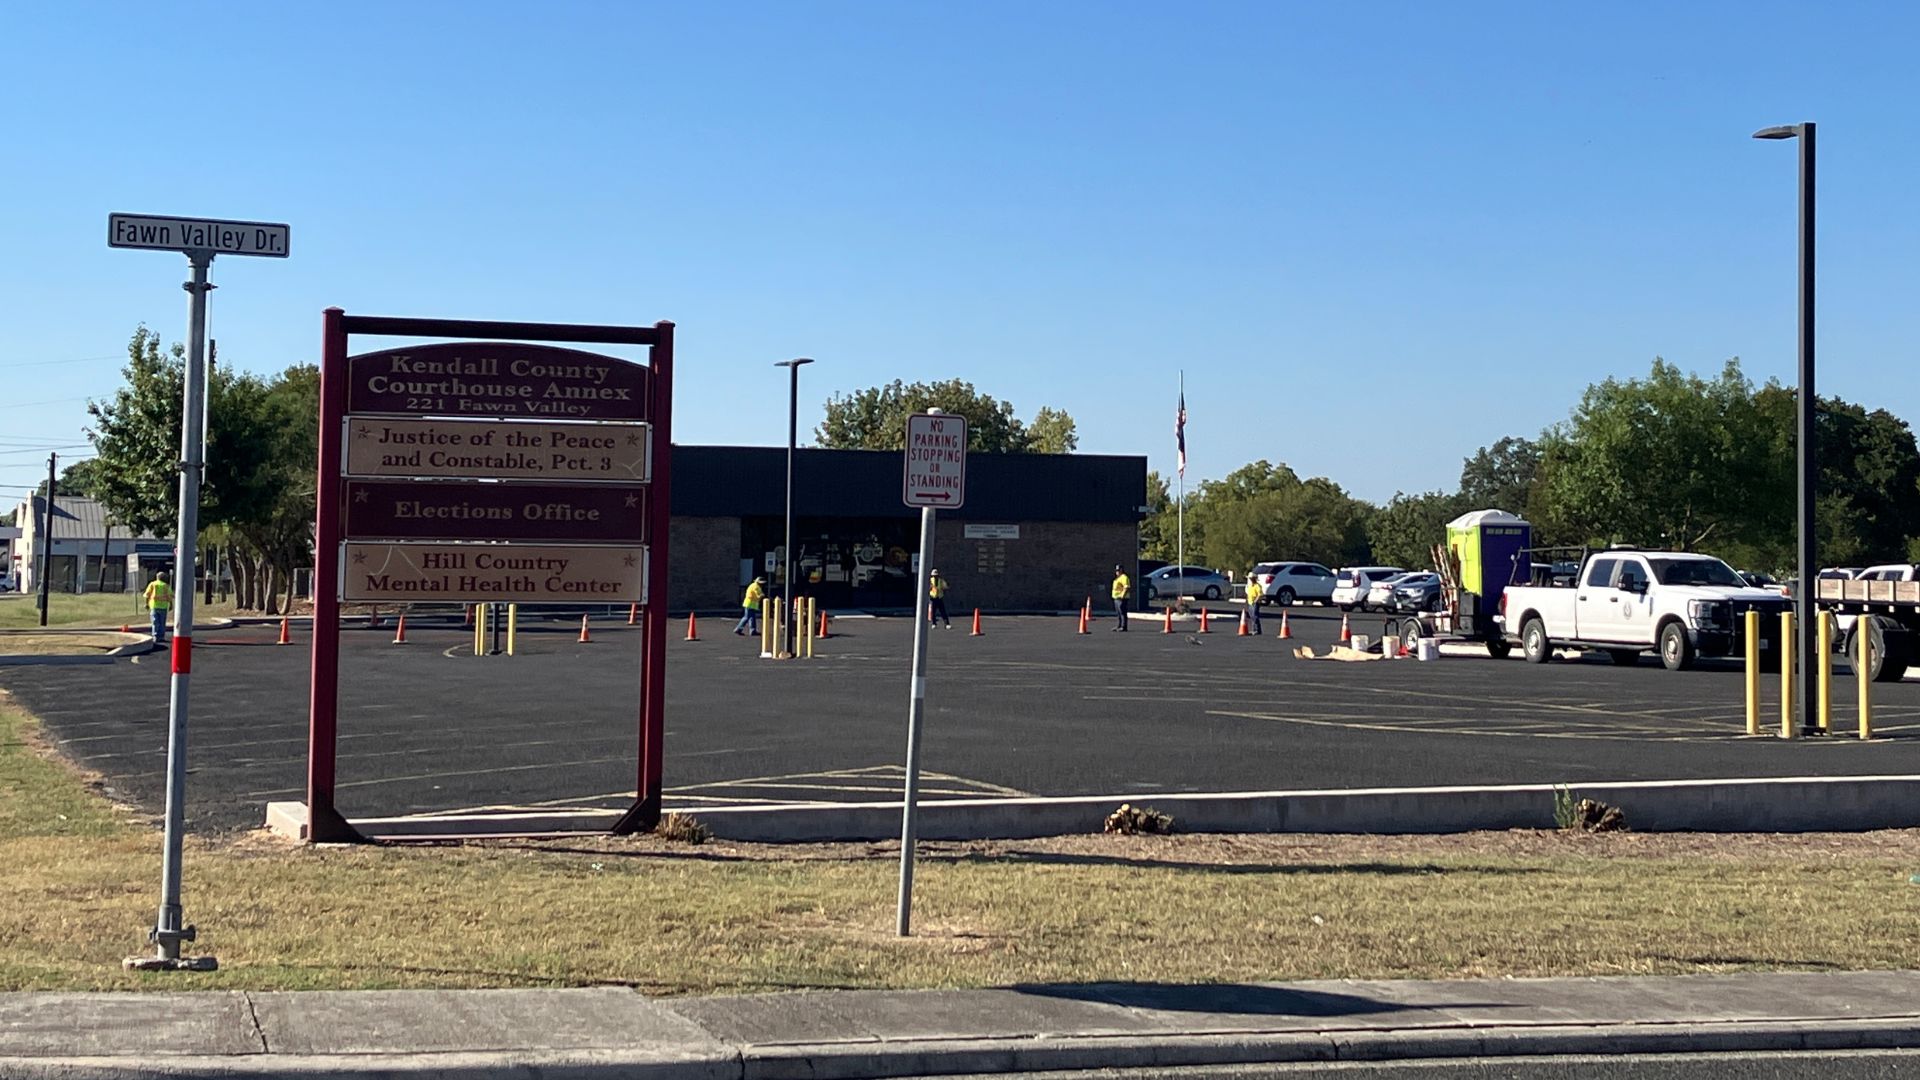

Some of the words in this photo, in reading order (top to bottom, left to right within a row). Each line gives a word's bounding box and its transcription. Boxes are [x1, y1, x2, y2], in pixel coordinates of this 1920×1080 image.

[116, 220, 170, 244] Fawn
[181, 224, 245, 250] Valley
[256, 229, 281, 252] Dr.
[390, 356, 499, 375] Kendall
[510, 360, 610, 384] County
[368, 376, 532, 398] Courthouse
[542, 382, 630, 400] Annex
[406, 398, 444, 410] 221
[458, 400, 517, 412] Fawn
[528, 401, 591, 416] Valley
[930, 420, 944, 432] NO
[378, 428, 462, 446] Justice
[470, 430, 494, 446] of
[506, 432, 542, 448] the
[552, 432, 616, 449] Peace
[914, 434, 958, 448] PARKING
[382, 451, 420, 468] and
[430, 452, 543, 472] Constable,
[552, 454, 592, 471] Pct.
[600, 456, 612, 471] 3
[910, 448, 960, 462] STOPPING
[930, 463, 940, 472] OR
[910, 474, 958, 488] STANDING
[394, 502, 513, 519] Elections
[524, 504, 600, 522] Office
[422, 553, 466, 570] Hill
[476, 554, 570, 575] Country
[366, 575, 449, 592] Mental
[459, 576, 536, 592] Health
[545, 578, 622, 593] Center
